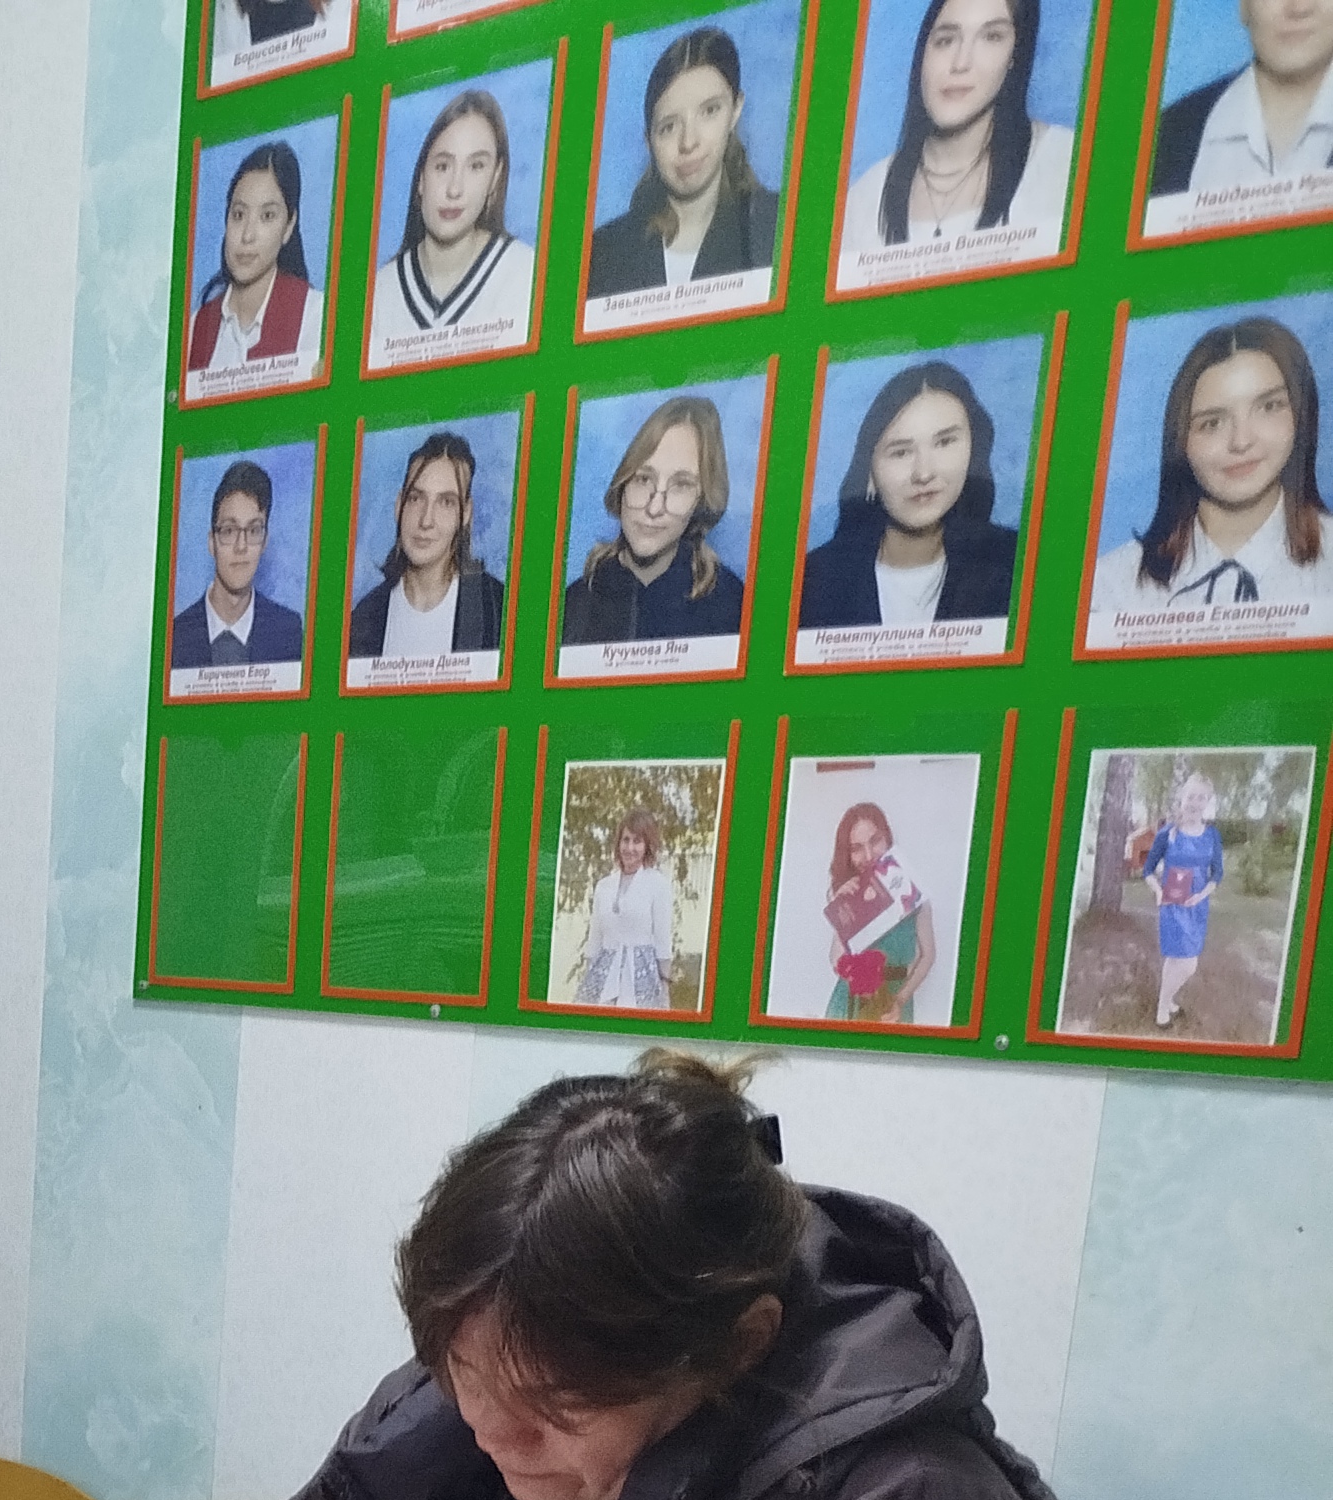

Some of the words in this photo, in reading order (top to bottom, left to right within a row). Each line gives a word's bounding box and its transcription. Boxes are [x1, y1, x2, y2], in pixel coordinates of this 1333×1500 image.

[233, 41, 288, 66] Борисова
[291, 28, 327, 49] Ирина
[858, 242, 950, 267] Кочетыгова
[955, 227, 1037, 251] Виктория
[603, 290, 671, 312] Завьялова
[675, 278, 744, 300] Виталина
[384, 330, 448, 351] Запорожская
[452, 317, 514, 338] Александра
[269, 356, 299, 371] Алина
[1114, 610, 1205, 627] Николаева
[1210, 602, 1310, 621] Екатерина
[815, 627, 924, 645] Невмятуллина
[928, 624, 983, 639] Карина
[602, 643, 662, 660] Кучумова
[665, 641, 689, 654] Яна
[198, 669, 245, 681] Кириченко
[248, 666, 270, 679] Егор
[371, 657, 434, 672] Молодухина
[436, 655, 471, 671] Диана
